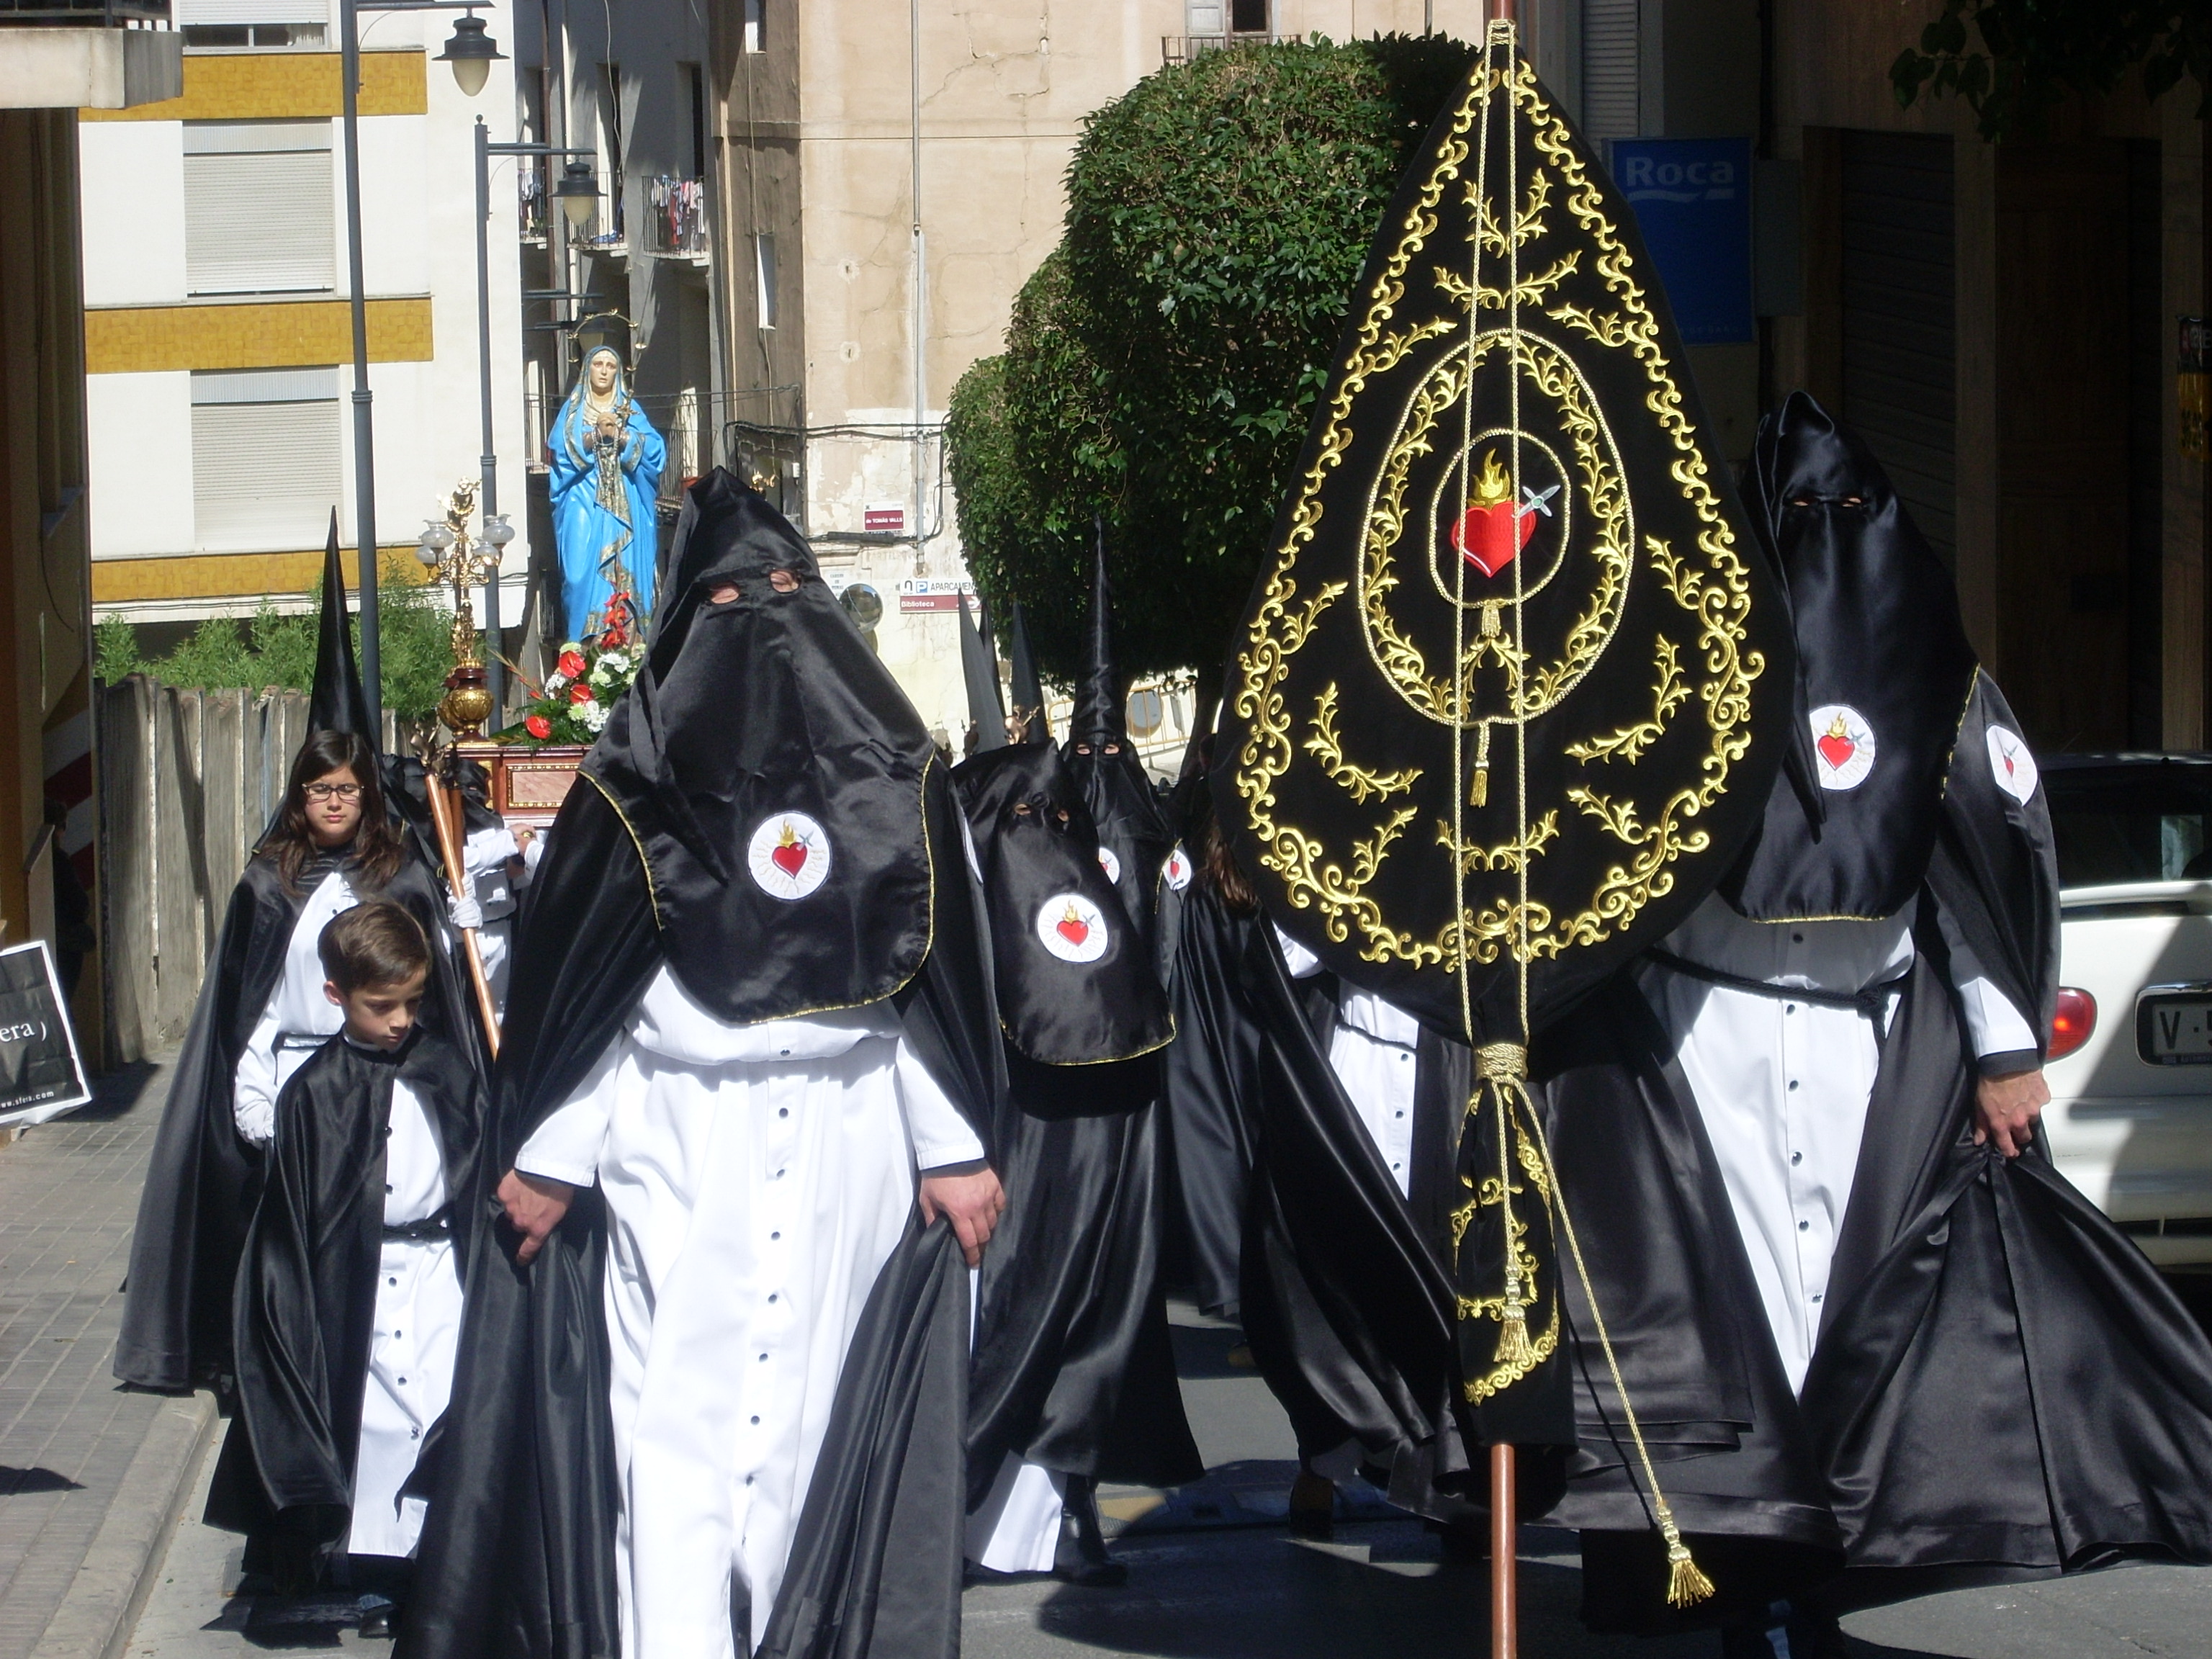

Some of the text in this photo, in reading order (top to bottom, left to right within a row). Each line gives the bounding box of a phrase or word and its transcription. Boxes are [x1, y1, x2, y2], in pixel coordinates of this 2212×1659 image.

[1626, 156, 1735, 186] Roca
[930, 582, 976, 590] APARCAMEN
[0, 1091, 55, 1108] ww.sfera.com
